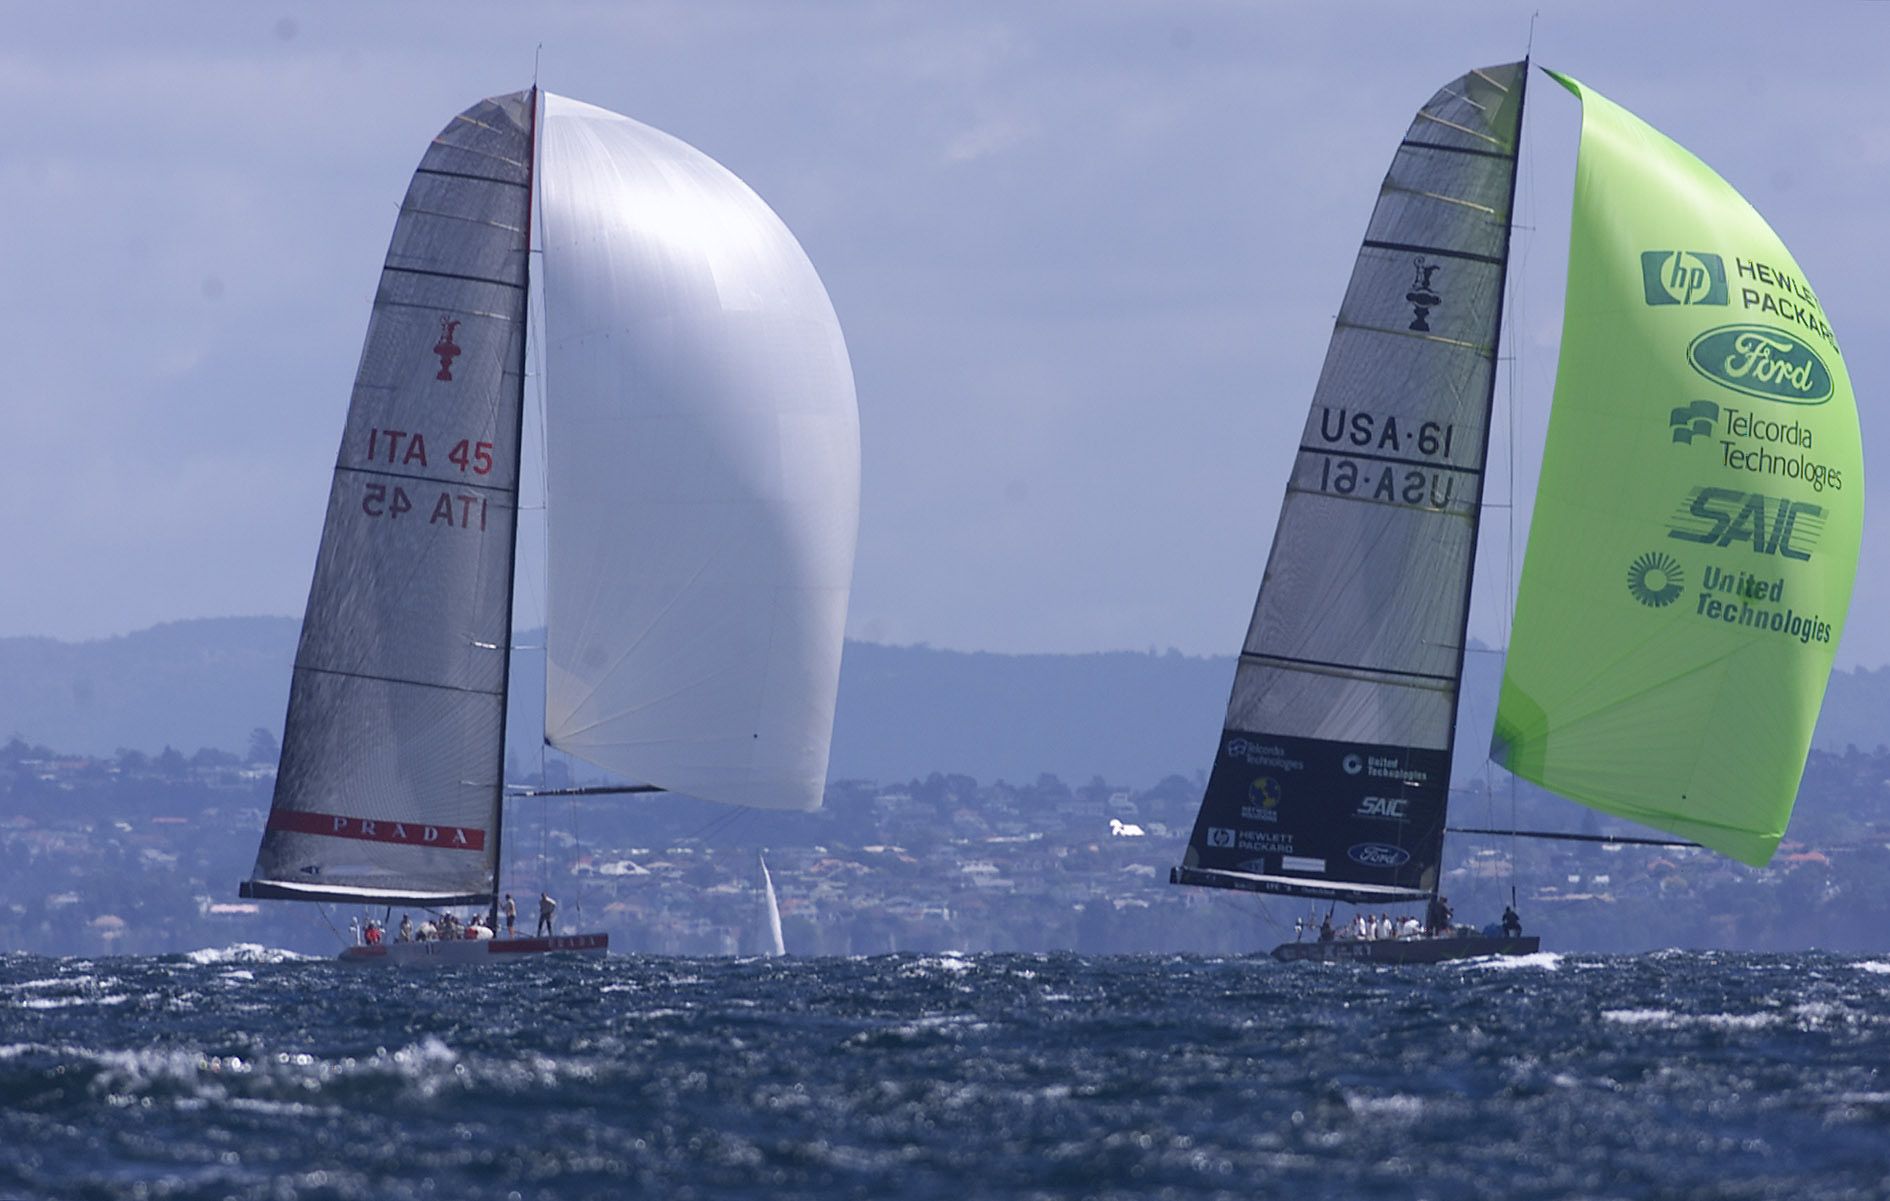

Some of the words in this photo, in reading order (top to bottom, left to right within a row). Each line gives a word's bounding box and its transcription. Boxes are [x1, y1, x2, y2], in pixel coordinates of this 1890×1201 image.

[1725, 333, 1813, 392] Ford
[1723, 407, 1813, 449] Telcordia
[367, 428, 427, 467] ITA
[448, 439, 494, 475] 45
[1719, 440, 1842, 492] Technologies
[1667, 485, 1824, 562] SAIC
[1703, 565, 1784, 603] United
[1696, 593, 1832, 644] Technologies
[1357, 796, 1408, 817] SAIC
[332, 816, 467, 845] PRADA
[1239, 831, 1294, 843] HEWLETT
[1239, 840, 1294, 853] PACKARD
[1360, 846, 1399, 865] Ford
